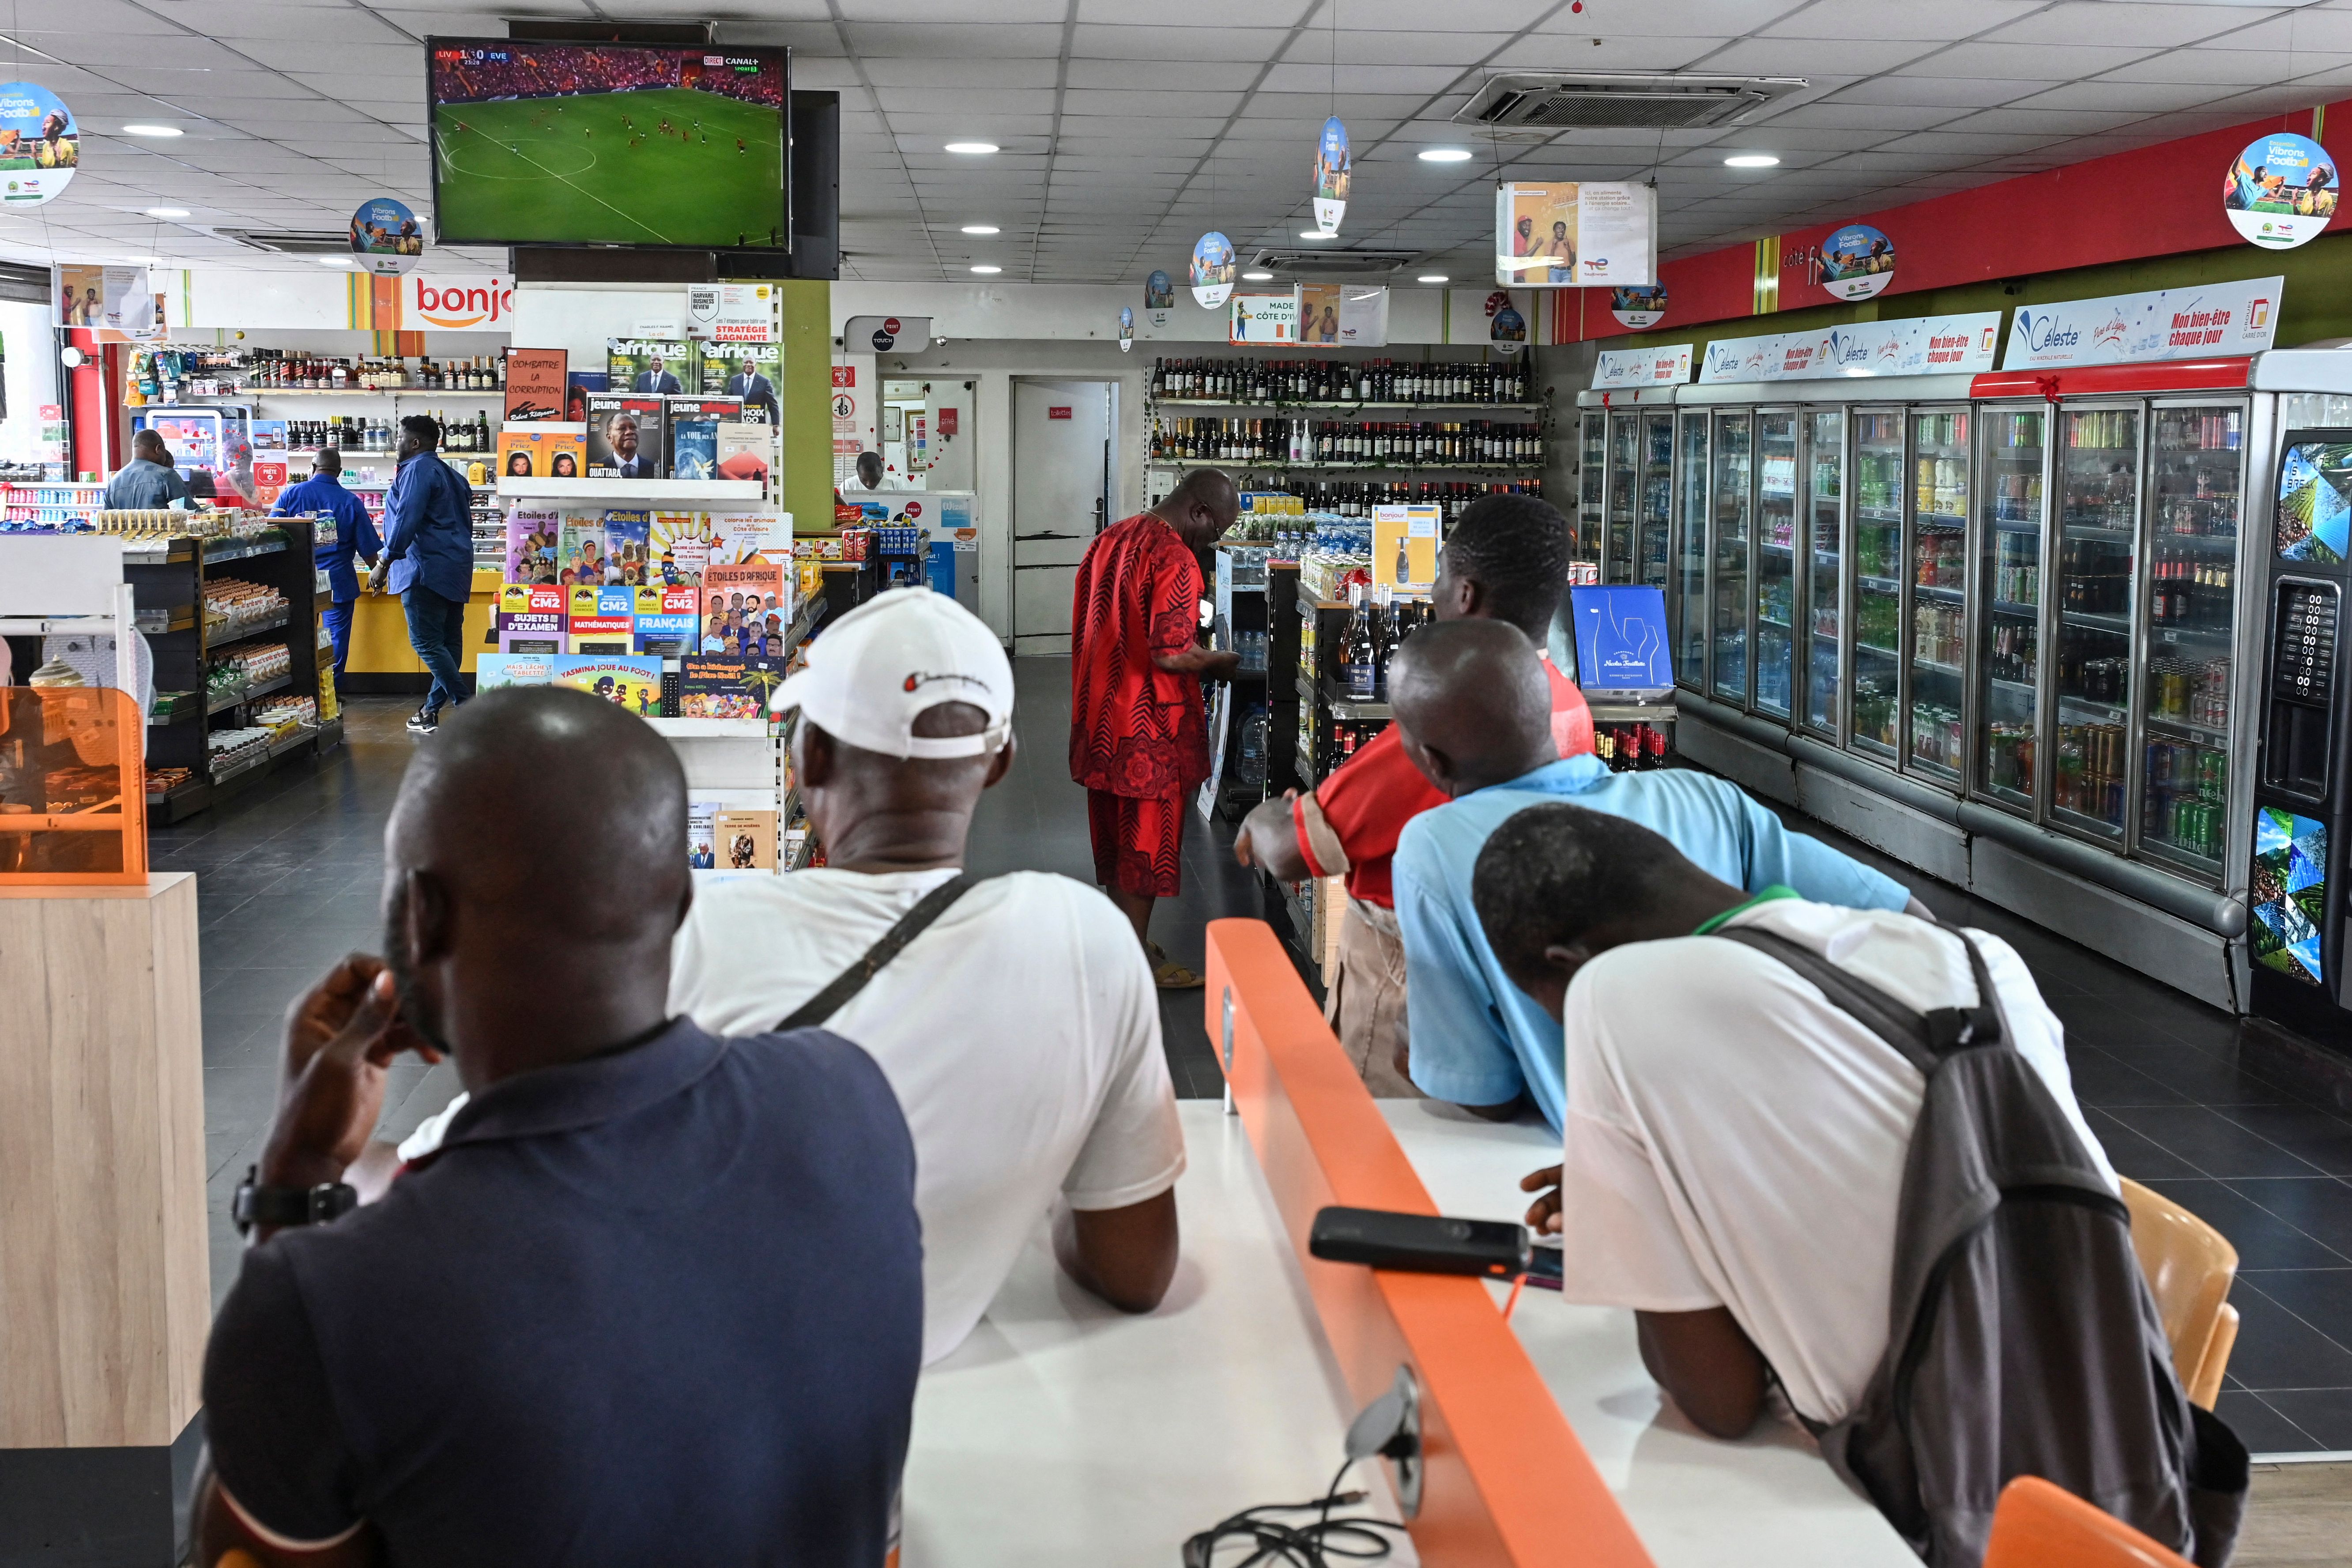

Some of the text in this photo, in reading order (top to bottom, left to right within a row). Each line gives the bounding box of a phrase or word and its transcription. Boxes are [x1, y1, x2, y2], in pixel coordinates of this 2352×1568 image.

[460, 50, 467, 59] 1
[477, 50, 484, 60] 0
[2269, 146, 2305, 157] Vibrons
[2266, 155, 2309, 167] Football
[1839, 234, 1864, 242] Vibrons
[1783, 246, 1803, 267] côté
[1256, 312, 1279, 320] CÔTE
[2171, 309, 2231, 329] Mon bien-être
[716, 324, 767, 333] STRATÉGIE
[2031, 315, 2078, 352] Céleste
[1929, 334, 1969, 349] Mon bien-être
[2169, 328, 2223, 347] chaque jour
[613, 340, 687, 356] afrique
[706, 343, 779, 359] afrique
[1838, 335, 1867, 365] Céleste
[1714, 348, 1739, 373] Céleste
[1927, 350, 1963, 364] chaque jour
[513, 360, 560, 369] COMBATTRE
[1604, 358, 1624, 379] Céleste
[1783, 359, 1808, 371] chaque jour
[509, 385, 561, 394] CORRUPTION
[590, 398, 621, 411] jeune
[670, 400, 700, 414] jeune
[942, 415, 954, 426] privé
[687, 431, 701, 440] VOIE
[589, 467, 622, 479] OUATTARA,
[2289, 466, 2298, 476] IS
[2287, 479, 2315, 490] BREAK
[2287, 491, 2307, 502] TIME
[517, 511, 547, 520] Etoiles
[565, 514, 594, 527] Étoiles
[613, 512, 641, 522] Etoiles
[816, 541, 822, 550] LU
[708, 569, 777, 582] ÉTOILES D'AFRIQUE
[531, 597, 560, 608] CM2
[599, 601, 628, 611] CM2
[664, 599, 693, 609] CM2
[514, 614, 549, 622] SUJETS
[508, 622, 558, 631] D'EXAMEN
[574, 620, 629, 629] MATHÉMATIQUES
[639, 618, 694, 631] FRANÇAIS
[561, 665, 596, 678] YASMINA
[630, 667, 650, 678] FOOT
[707, 662, 746, 672] kidnappé
